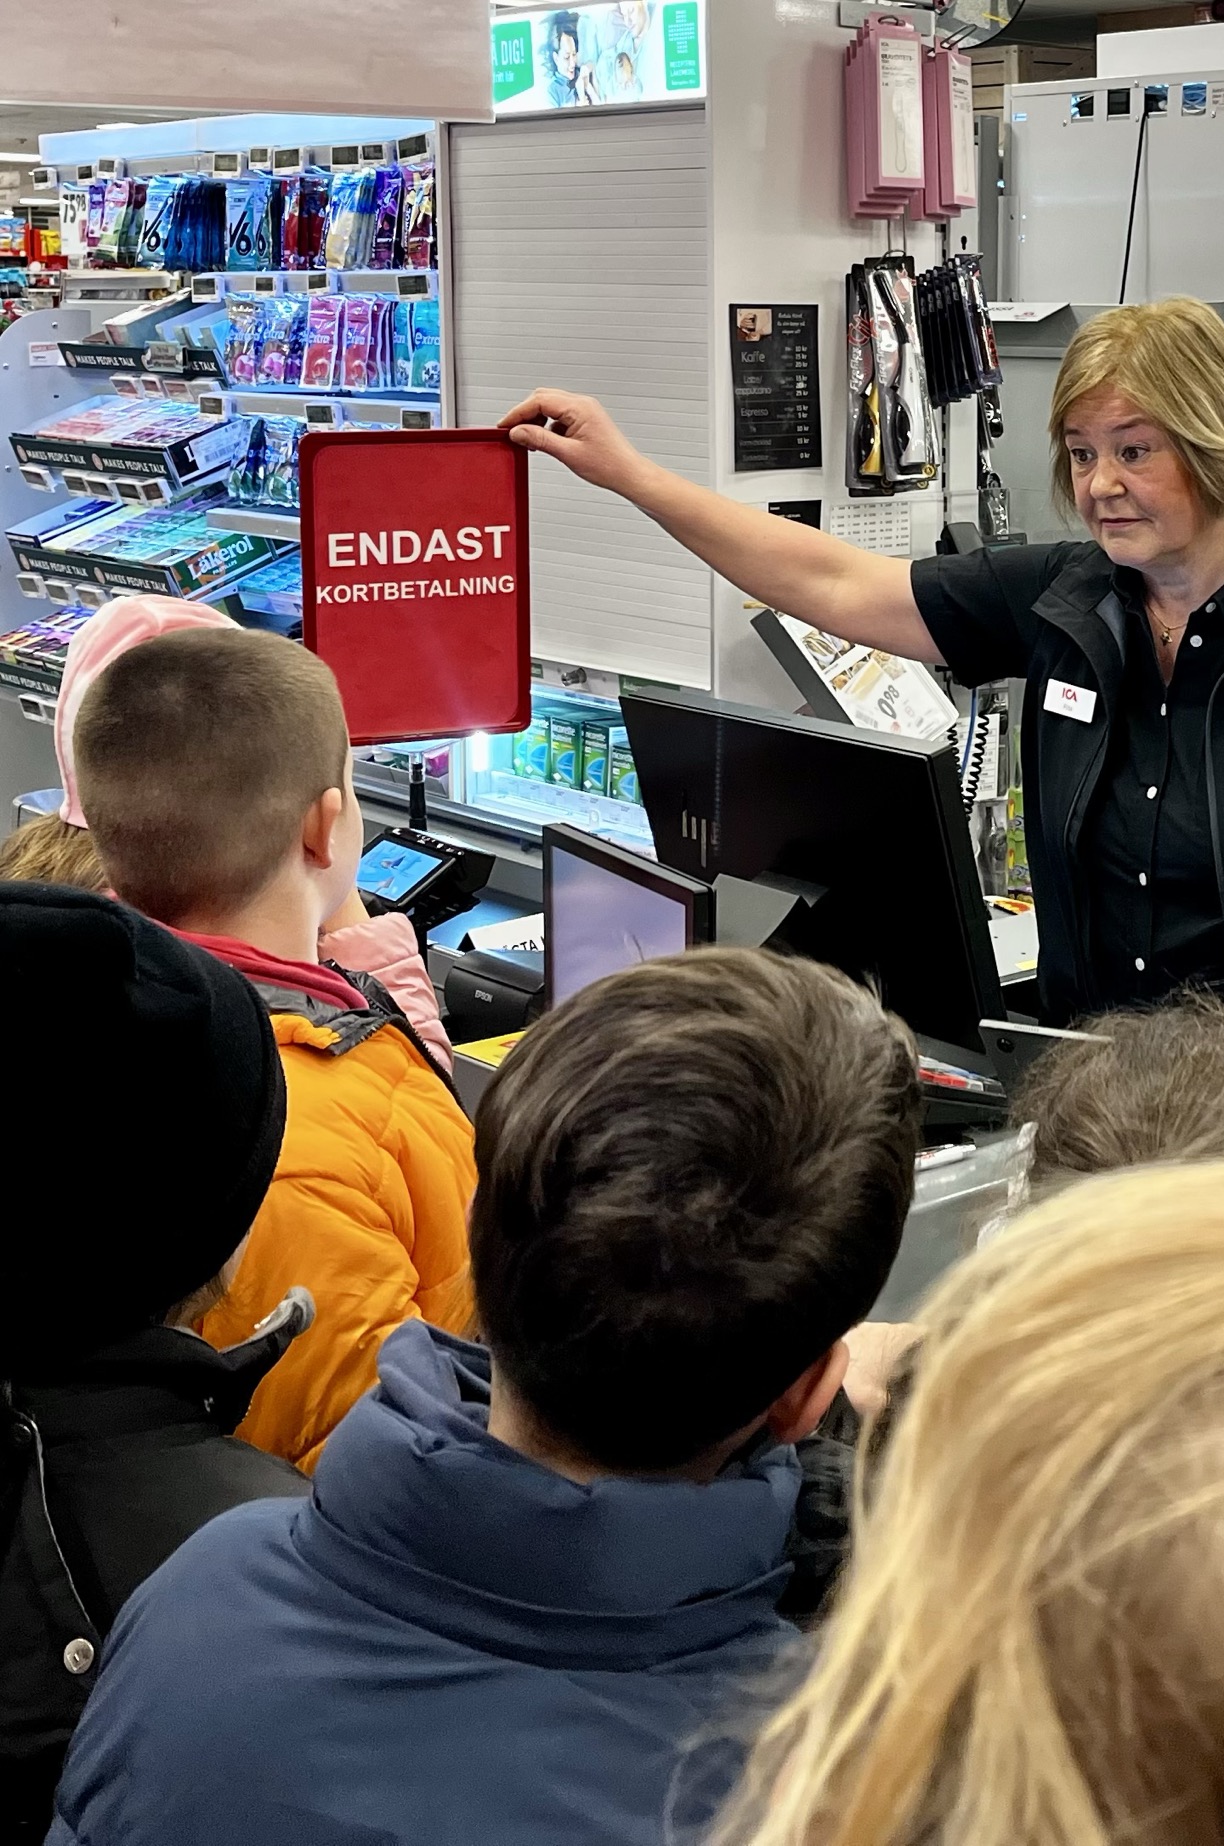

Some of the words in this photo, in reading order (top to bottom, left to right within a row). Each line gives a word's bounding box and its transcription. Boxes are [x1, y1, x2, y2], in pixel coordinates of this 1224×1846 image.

[501, 38, 525, 65] DIG!
[415, 332, 440, 345] extra
[75, 355, 97, 365] MAKES
[96, 356, 120, 366] PEOPLE
[120, 357, 136, 367] TALK
[741, 351, 765, 363] Kaffe
[199, 361, 218, 371] TALK
[740, 408, 769, 418] Espresso
[26, 450, 47, 460] MAKES
[47, 451, 71, 463] PEOPLE
[69, 454, 86, 464] TALK
[102, 458, 125, 469] MAKES
[125, 461, 149, 472] PEOPLE
[148, 463, 167, 474] TALK
[328, 525, 511, 568] ENDAST
[188, 535, 254, 580] Läkerol
[29, 558, 50, 569] MAKES
[50, 561, 73, 573] PEOPLE
[72, 565, 88, 577] TALK
[104, 572, 127, 584] MAKES
[126, 575, 150, 588] PEOPLE
[149, 579, 168, 592] TALK
[316, 575, 515, 604] KORTBETALNING
[20, 677, 43, 691] PEOPLE
[41, 682, 58, 694] TALK
[1062, 687, 1077, 702] ICA
[475, 989, 493, 1003] EPSON
